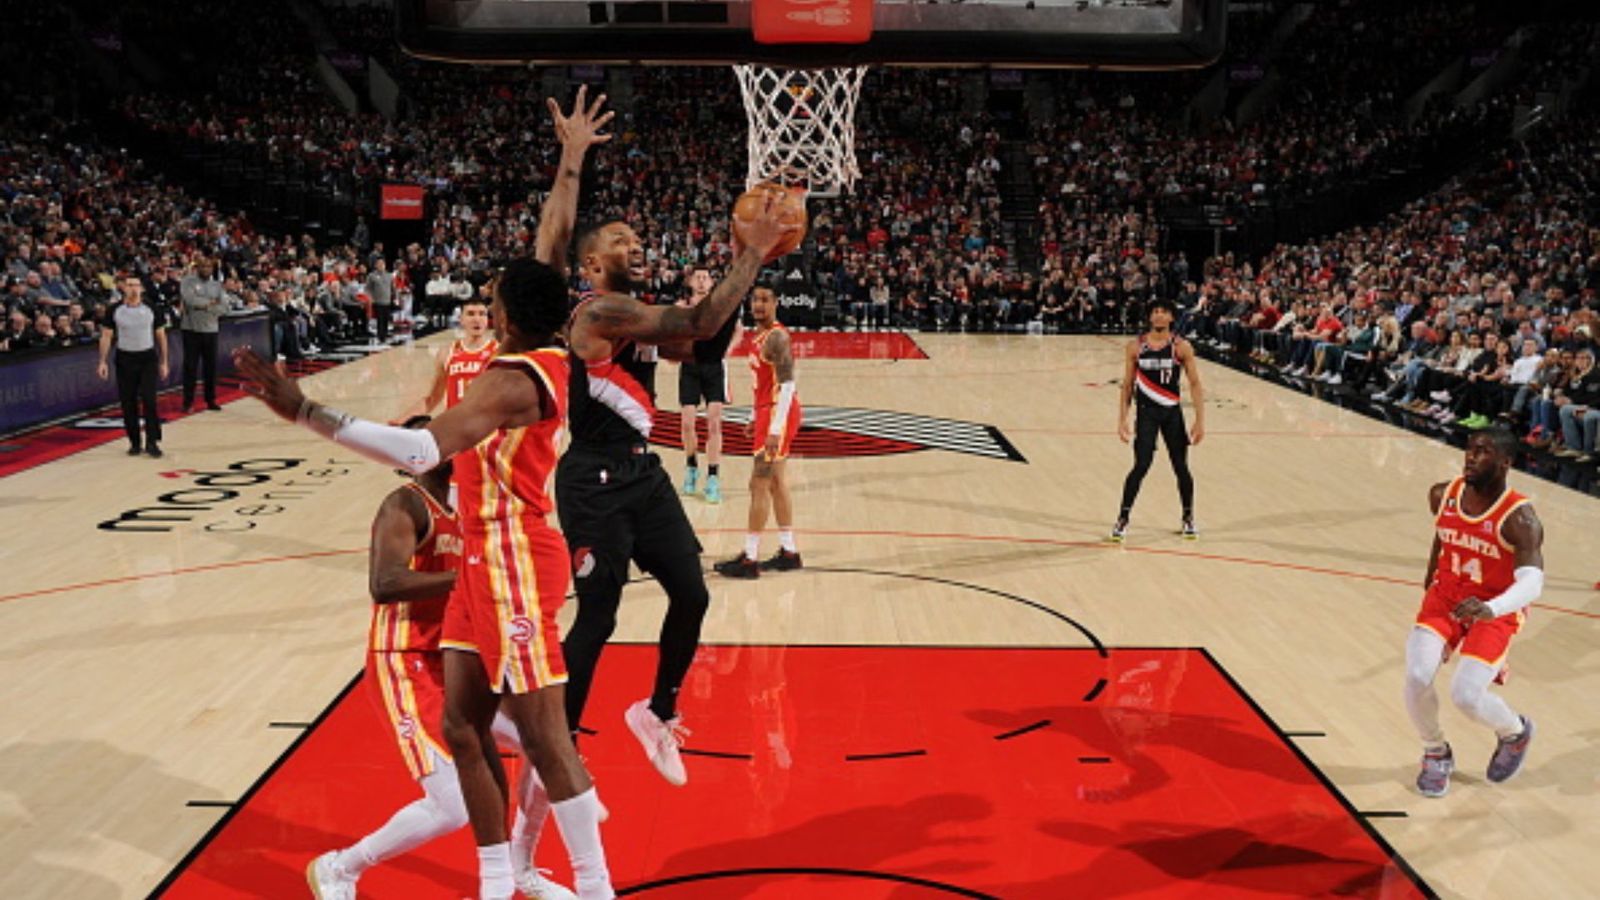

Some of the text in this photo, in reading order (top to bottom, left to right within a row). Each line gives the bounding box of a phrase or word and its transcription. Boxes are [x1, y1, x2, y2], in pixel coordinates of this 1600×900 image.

[1160, 369, 1173, 385] 17
[97, 457, 306, 532] moda
[204, 458, 363, 532] center
[1437, 527, 1502, 560] ATLANTA
[1450, 552, 1483, 584] 14
